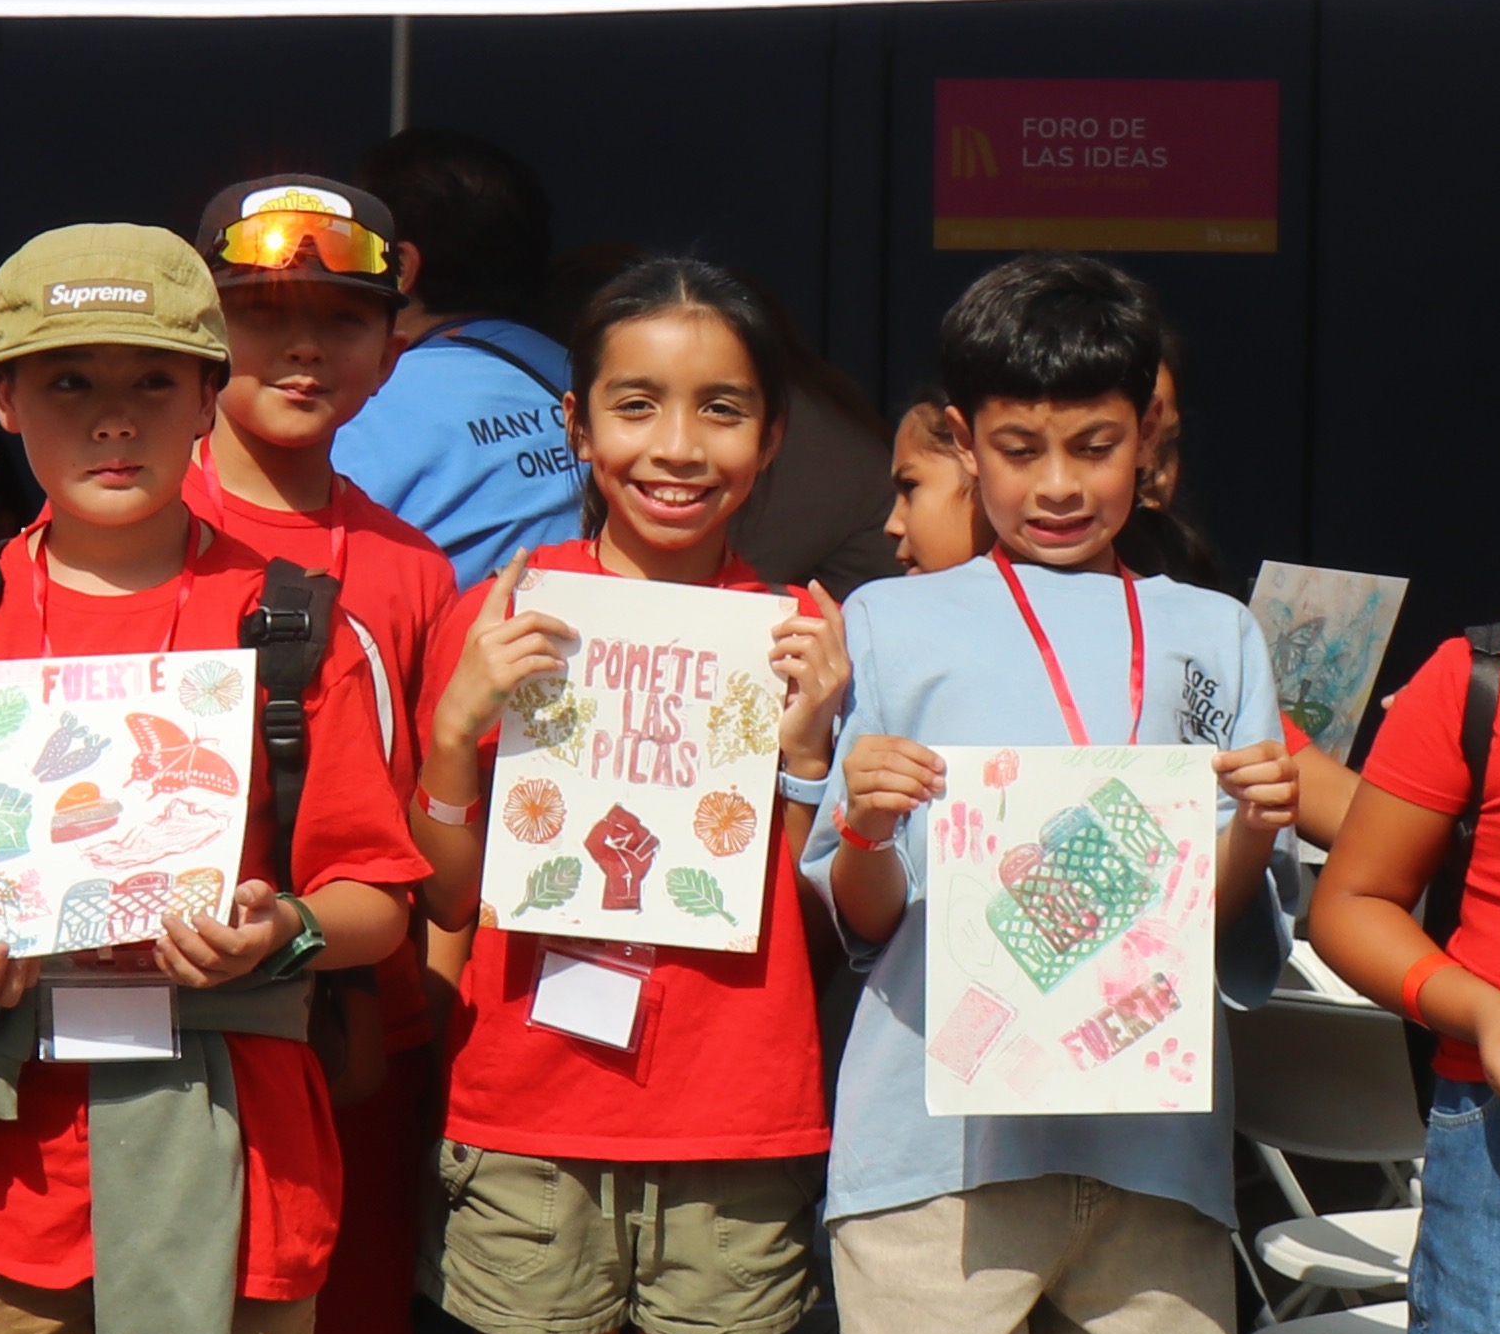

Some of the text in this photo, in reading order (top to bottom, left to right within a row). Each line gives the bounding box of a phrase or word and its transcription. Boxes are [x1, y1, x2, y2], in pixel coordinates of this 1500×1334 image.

[1022, 117, 1148, 140] FORO DE
[1022, 146, 1168, 169] LAS IDEAS
[50, 282, 148, 307] Supreme
[467, 409, 544, 446] MANY
[41, 655, 166, 705] FUERTE
[622, 689, 683, 744] LAS
[591, 729, 699, 788] PILAS
